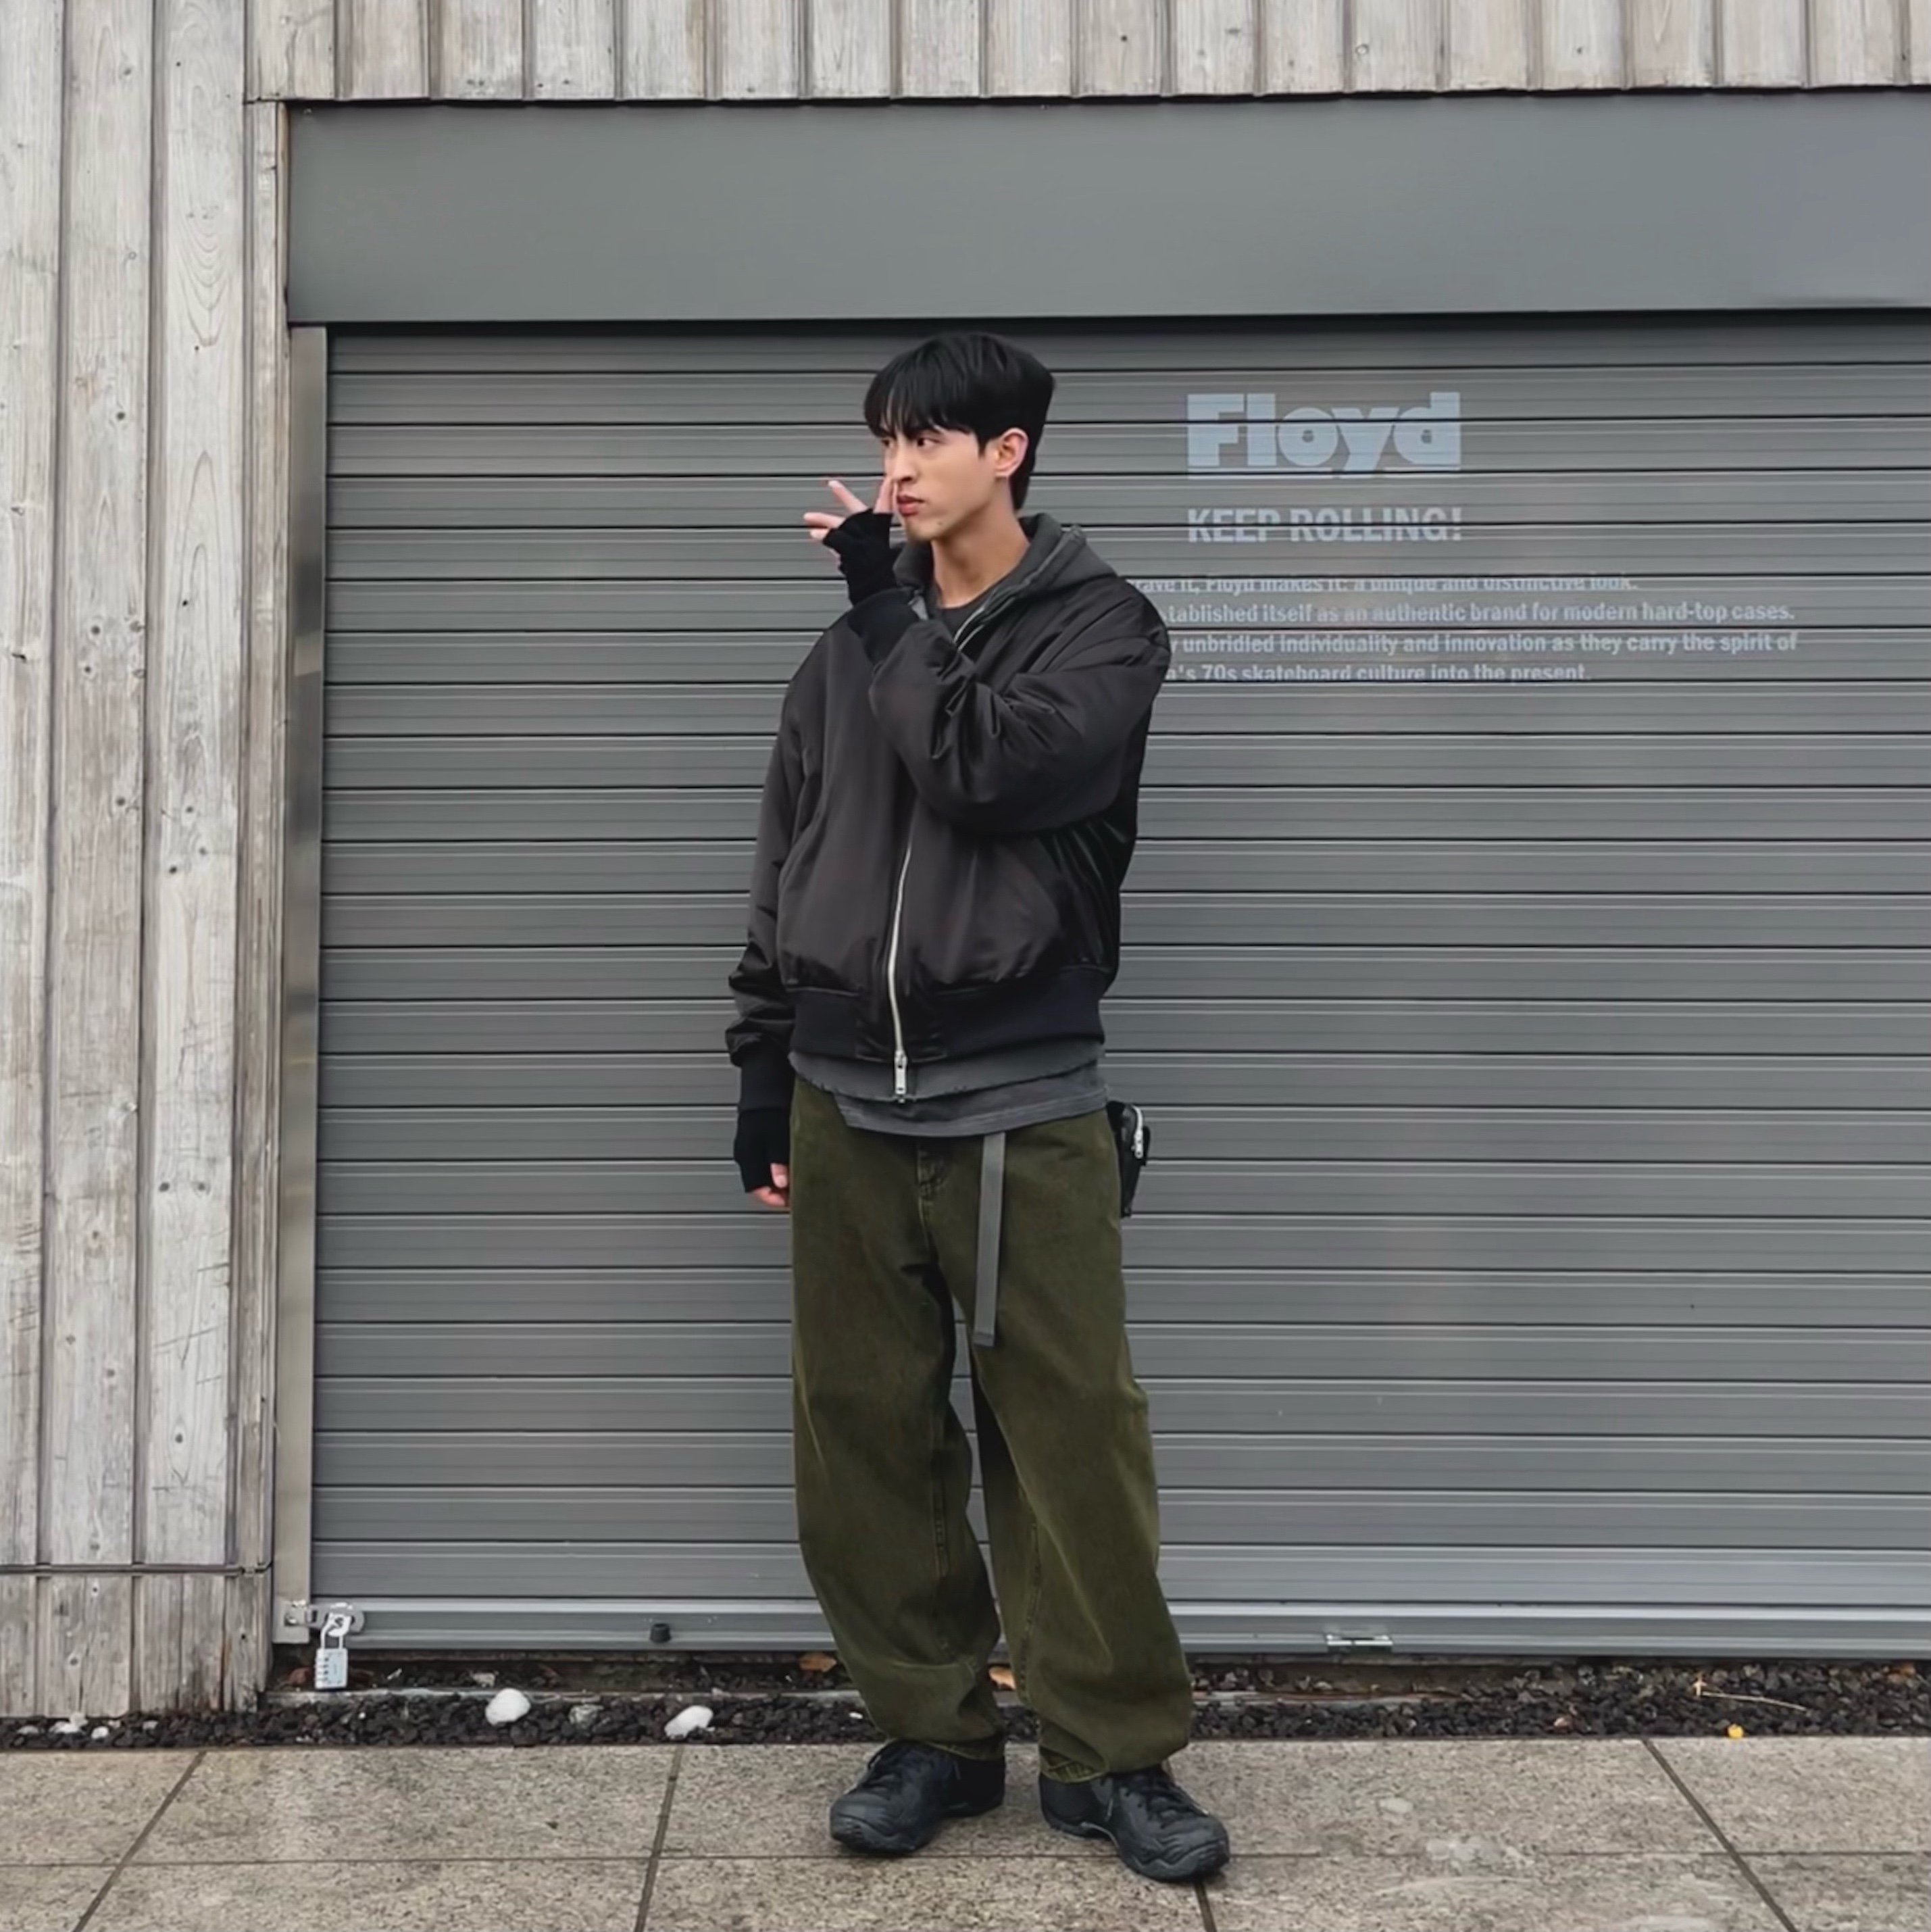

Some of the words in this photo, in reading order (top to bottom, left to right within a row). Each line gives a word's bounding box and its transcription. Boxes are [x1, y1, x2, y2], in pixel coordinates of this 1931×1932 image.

[1187, 392, 1461, 478] Floyd
[1188, 507, 1280, 543] KEEP
[1290, 507, 1461, 542] ROLLING!
[1134, 578, 1176, 592] rave
[1261, 578, 1324, 592] makes
[1371, 578, 1438, 595] unique
[1441, 578, 1478, 592] and
[1484, 577, 1585, 592] distinctive
[1263, 603, 1311, 622] itself
[1318, 608, 1338, 622] as
[1345, 608, 1368, 622] an
[1372, 603, 1466, 622] authentic
[1470, 602, 1526, 622] brand
[1532, 601, 1558, 621] for
[1563, 601, 1637, 621] modern
[1642, 601, 1728, 624] hard-top
[1732, 605, 1795, 620] cases.
[1183, 634, 1274, 653] unbridled
[1280, 634, 1398, 656] individuality
[1403, 635, 1440, 652] and
[1446, 634, 1547, 651] innovation
[1552, 637, 1575, 651] as
[1580, 634, 1622, 655] they
[1626, 637, 1678, 655] carry
[1682, 633, 1715, 651] the
[1720, 633, 1772, 654] spirit
[1777, 631, 1799, 651] of
[1201, 664, 1238, 680] 70s
[1242, 664, 1351, 680] skateboard
[1357, 664, 1426, 680] culture
[1430, 664, 1469, 680] into
[1474, 664, 1505, 680] the
